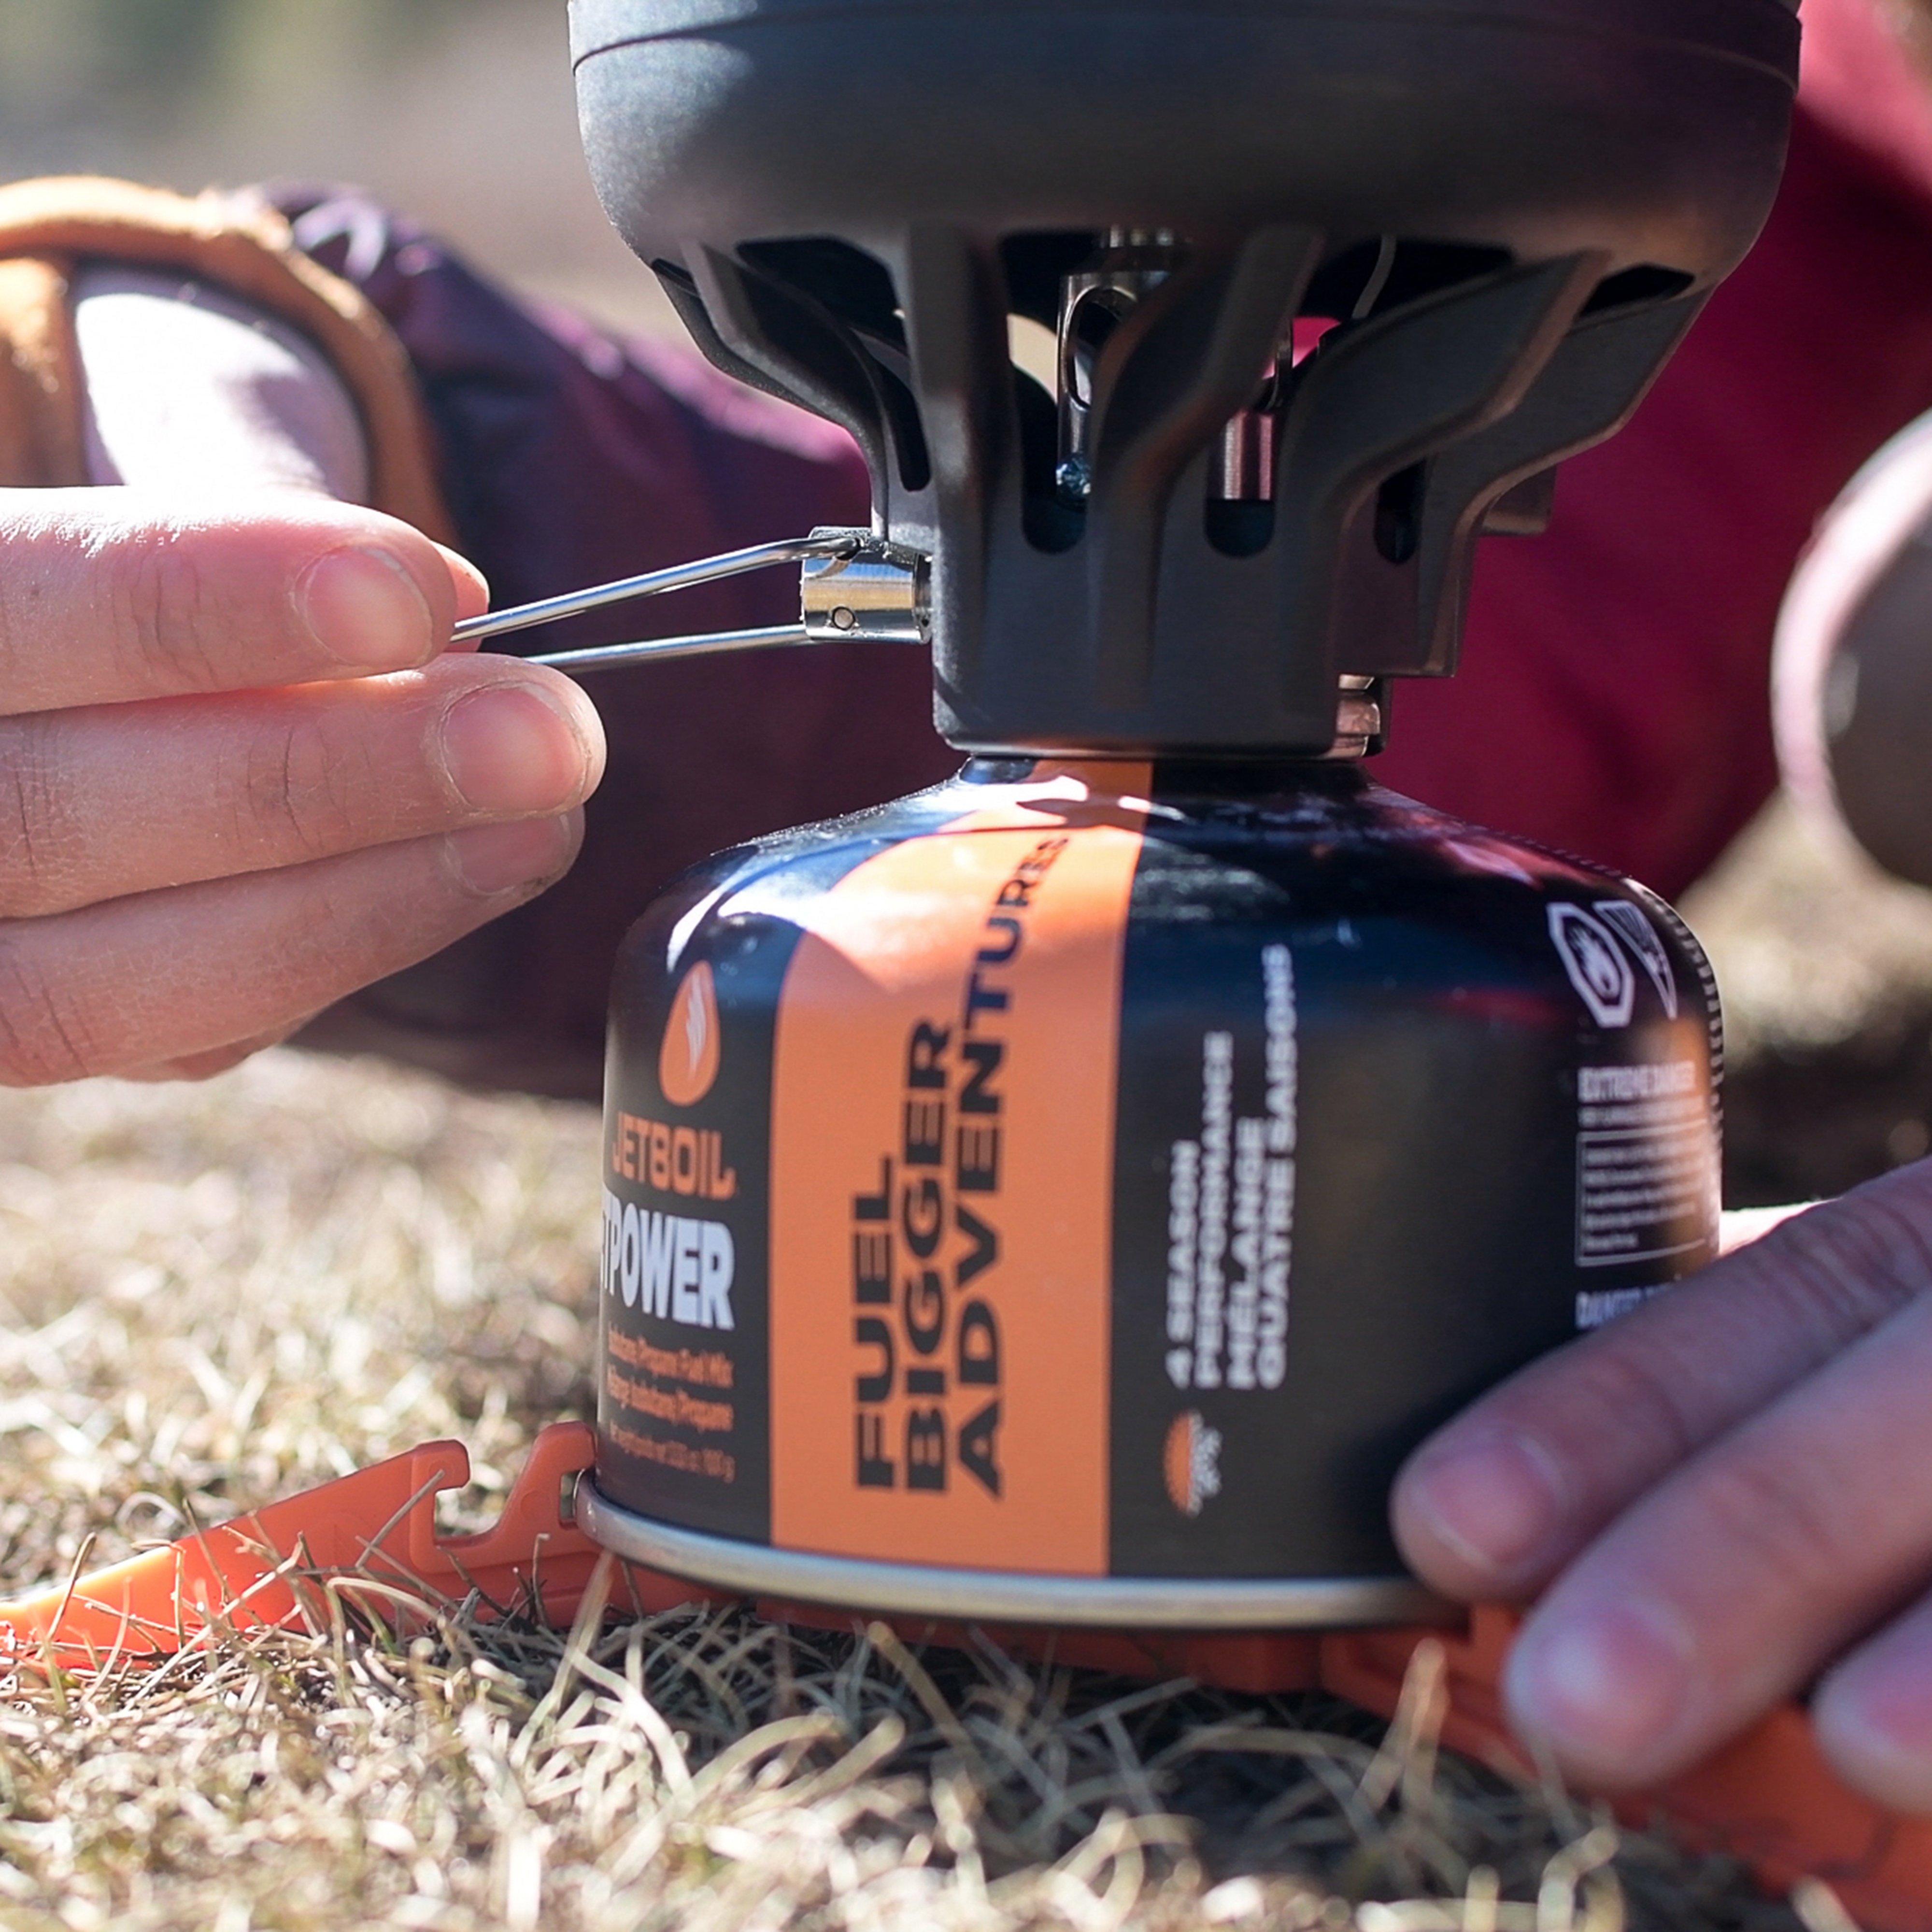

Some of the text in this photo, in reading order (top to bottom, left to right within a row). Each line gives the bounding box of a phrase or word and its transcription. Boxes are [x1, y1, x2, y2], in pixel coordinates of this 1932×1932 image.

[611, 1111, 737, 1200] JETBOIL
[854, 1155, 895, 1489] FUEL
[904, 1020, 950, 1492] BIGGER
[954, 838, 1068, 1499] ADVENTURES
[1165, 1139, 1201, 1390] 4 SEASON
[1194, 1030, 1234, 1390] PERFORMANCE
[1225, 1117, 1264, 1390] MÉLANGE
[1257, 943, 1298, 1390] QUATRE SAISONS
